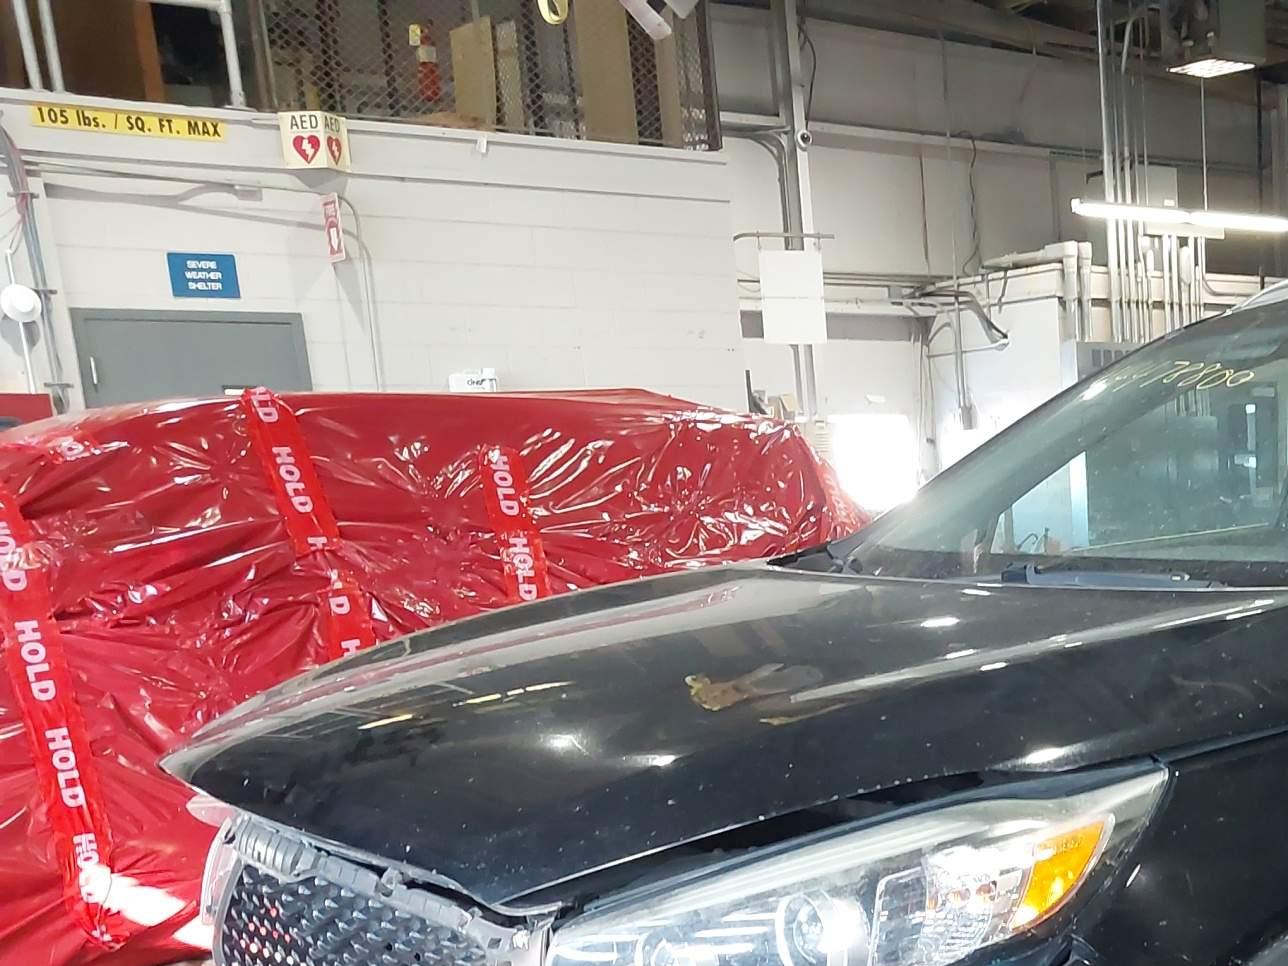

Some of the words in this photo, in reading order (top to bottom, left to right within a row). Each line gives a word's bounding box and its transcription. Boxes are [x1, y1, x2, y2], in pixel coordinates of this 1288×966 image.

[37, 107, 69, 124] 105
[76, 109, 106, 129] lbs.
[126, 115, 152, 133] SQ.
[158, 118, 180, 135] FT.
[187, 120, 222, 138] MAX
[290, 114, 318, 130] AED
[324, 115, 340, 133] AED
[184, 271, 222, 280] WEATHER
[186, 260, 217, 269] SEVERE
[187, 281, 223, 290] SHELTER
[271, 446, 314, 513] HOLD
[490, 455, 520, 516] HOLD
[508, 537, 538, 601] HOLD
[14, 620, 57, 701] HOLD
[44, 726, 87, 808] HOLD
